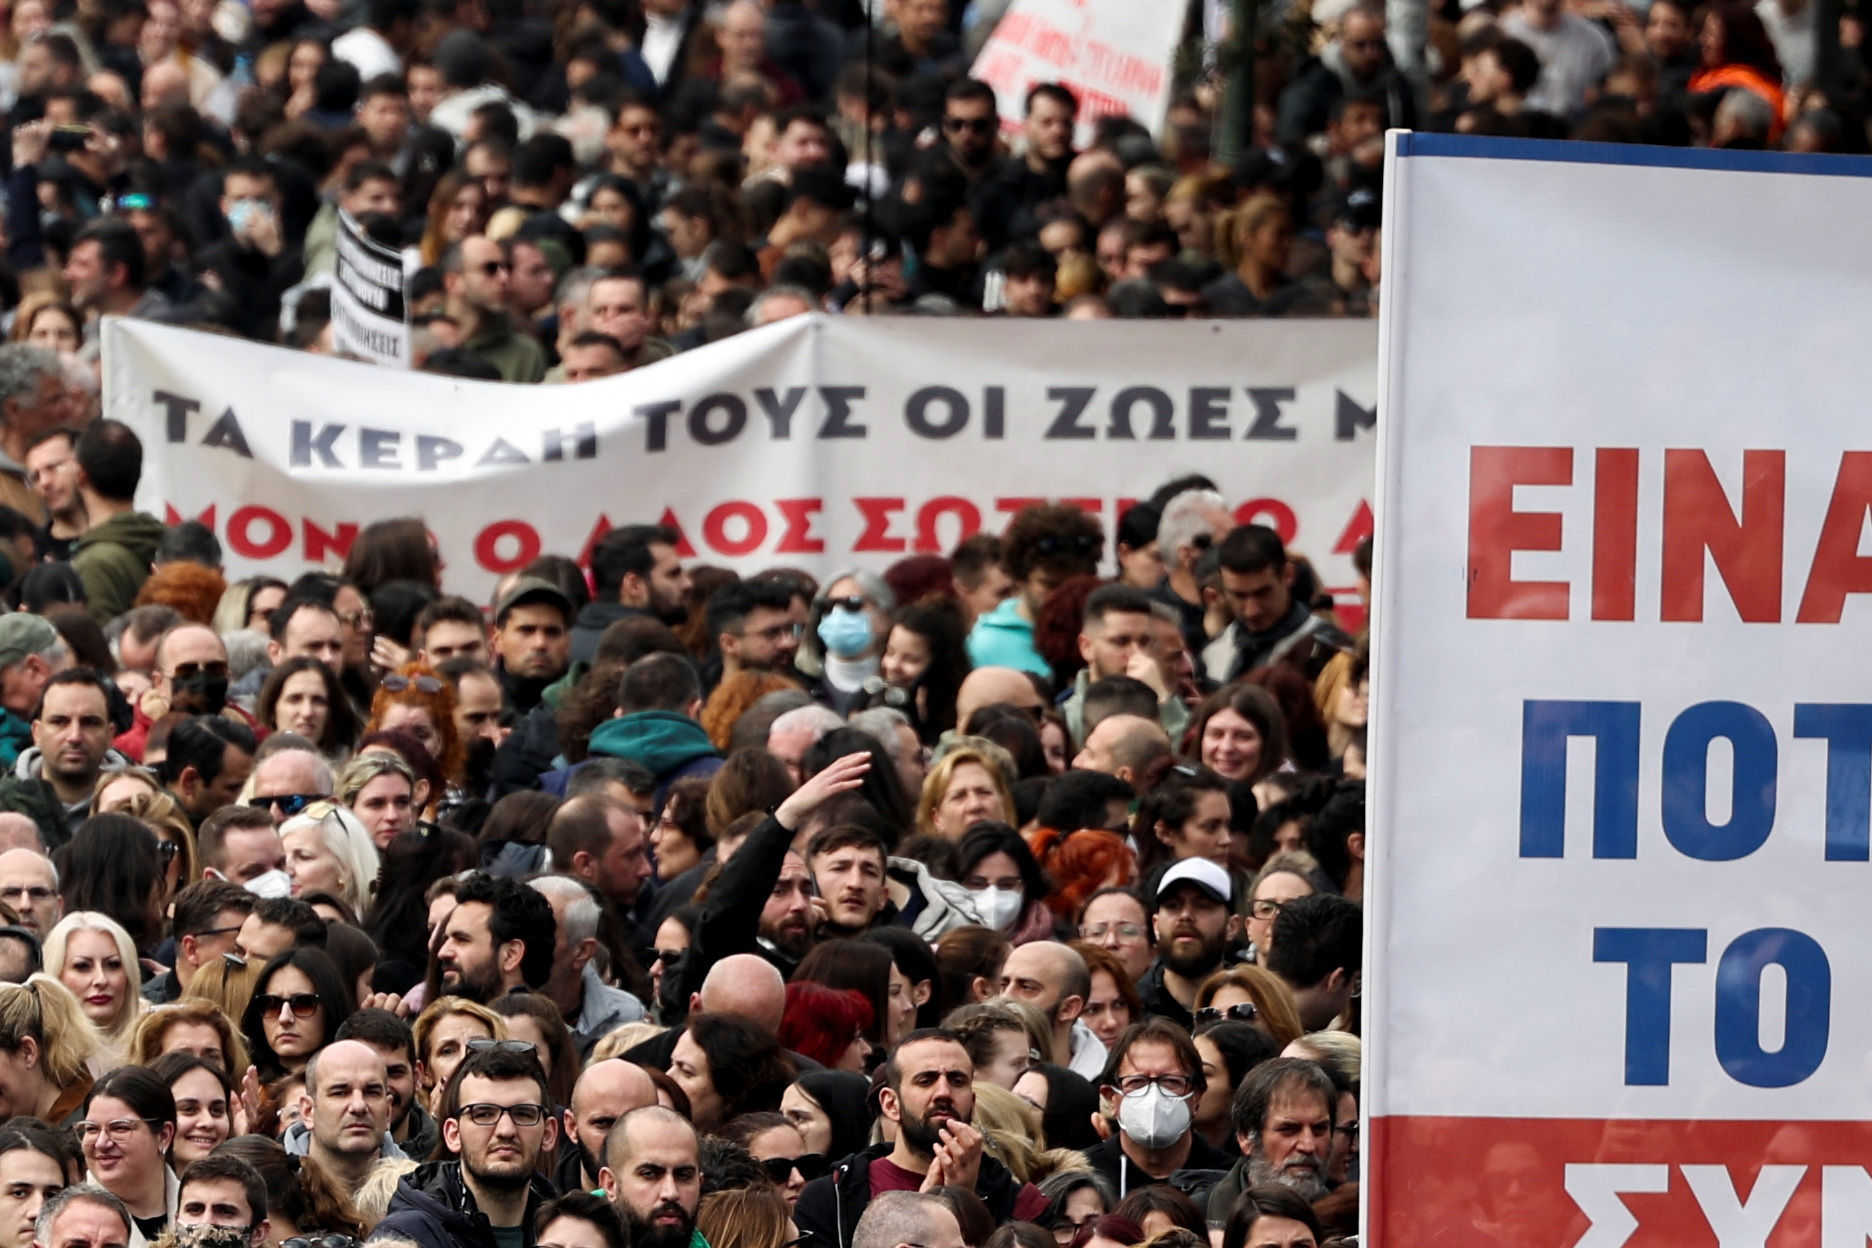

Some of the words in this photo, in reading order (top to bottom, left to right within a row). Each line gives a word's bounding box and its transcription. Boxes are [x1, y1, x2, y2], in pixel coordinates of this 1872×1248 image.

[153, 390, 254, 458] ΤΑ
[289, 420, 597, 472] ΚΕΡΔΗ
[634, 385, 868, 452] ΤΟΥΣ
[904, 384, 1005, 441] ΟΙ
[1044, 385, 1297, 442] ΖΩΕΣ
[163, 502, 439, 566] ΜΟΝ
[474, 519, 542, 574] Ο
[1466, 446, 1872, 624] ΕΙΝΑ
[1519, 699, 1872, 862] ΠΟΤ
[1592, 926, 1832, 1089] ΤΟ
